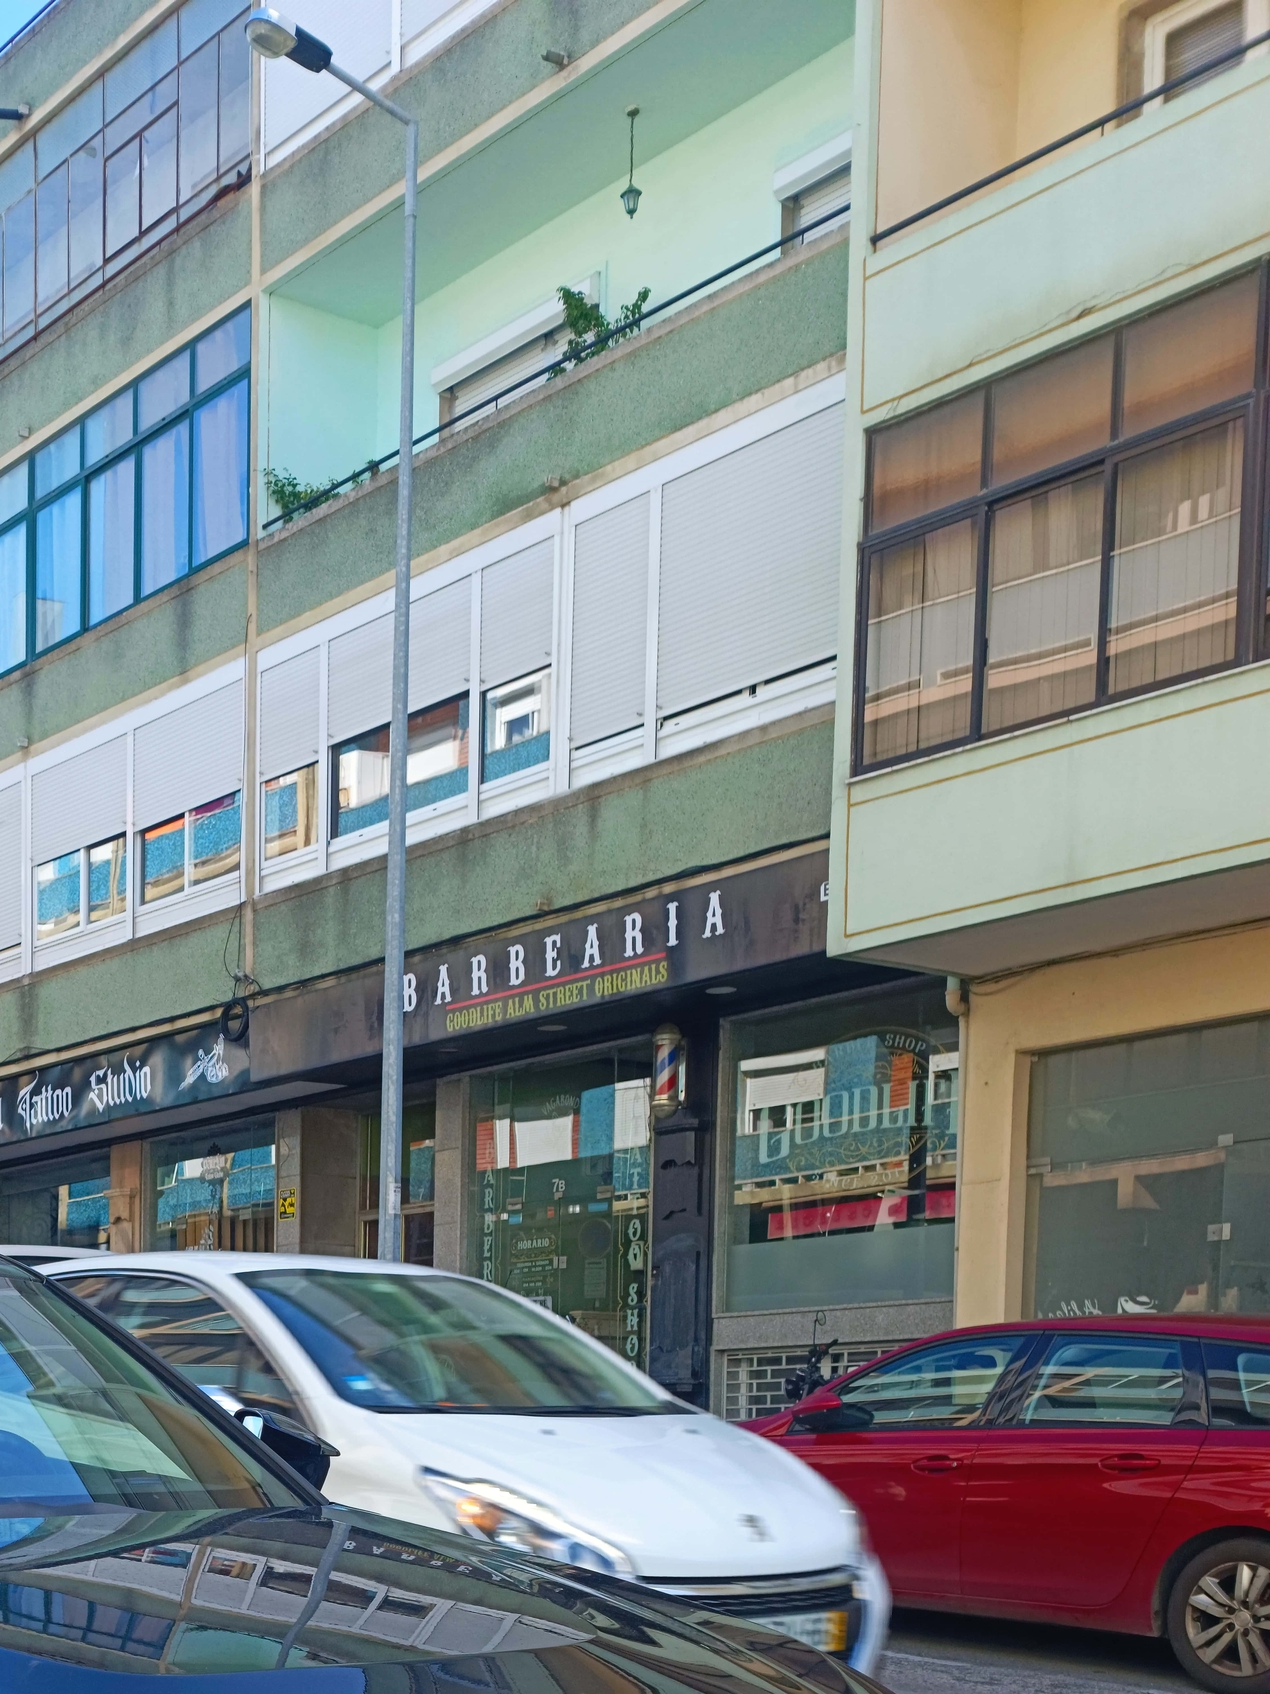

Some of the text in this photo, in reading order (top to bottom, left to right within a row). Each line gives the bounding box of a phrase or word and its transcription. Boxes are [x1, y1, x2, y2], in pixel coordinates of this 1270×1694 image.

[403, 889, 726, 1013] BARBEARIA
[446, 961, 668, 1032] GOODLIFE ALM STREET ORIGINALS
[885, 1033, 927, 1053] SHOP
[17, 1070, 73, 1137] Tattoo
[88, 1052, 152, 1113] Studio
[541, 1094, 580, 1116] VAGABOND
[551, 1178, 566, 1192] 7B
[482, 1139, 495, 1281] BARBER
[517, 1235, 550, 1250] HORÁRIO
